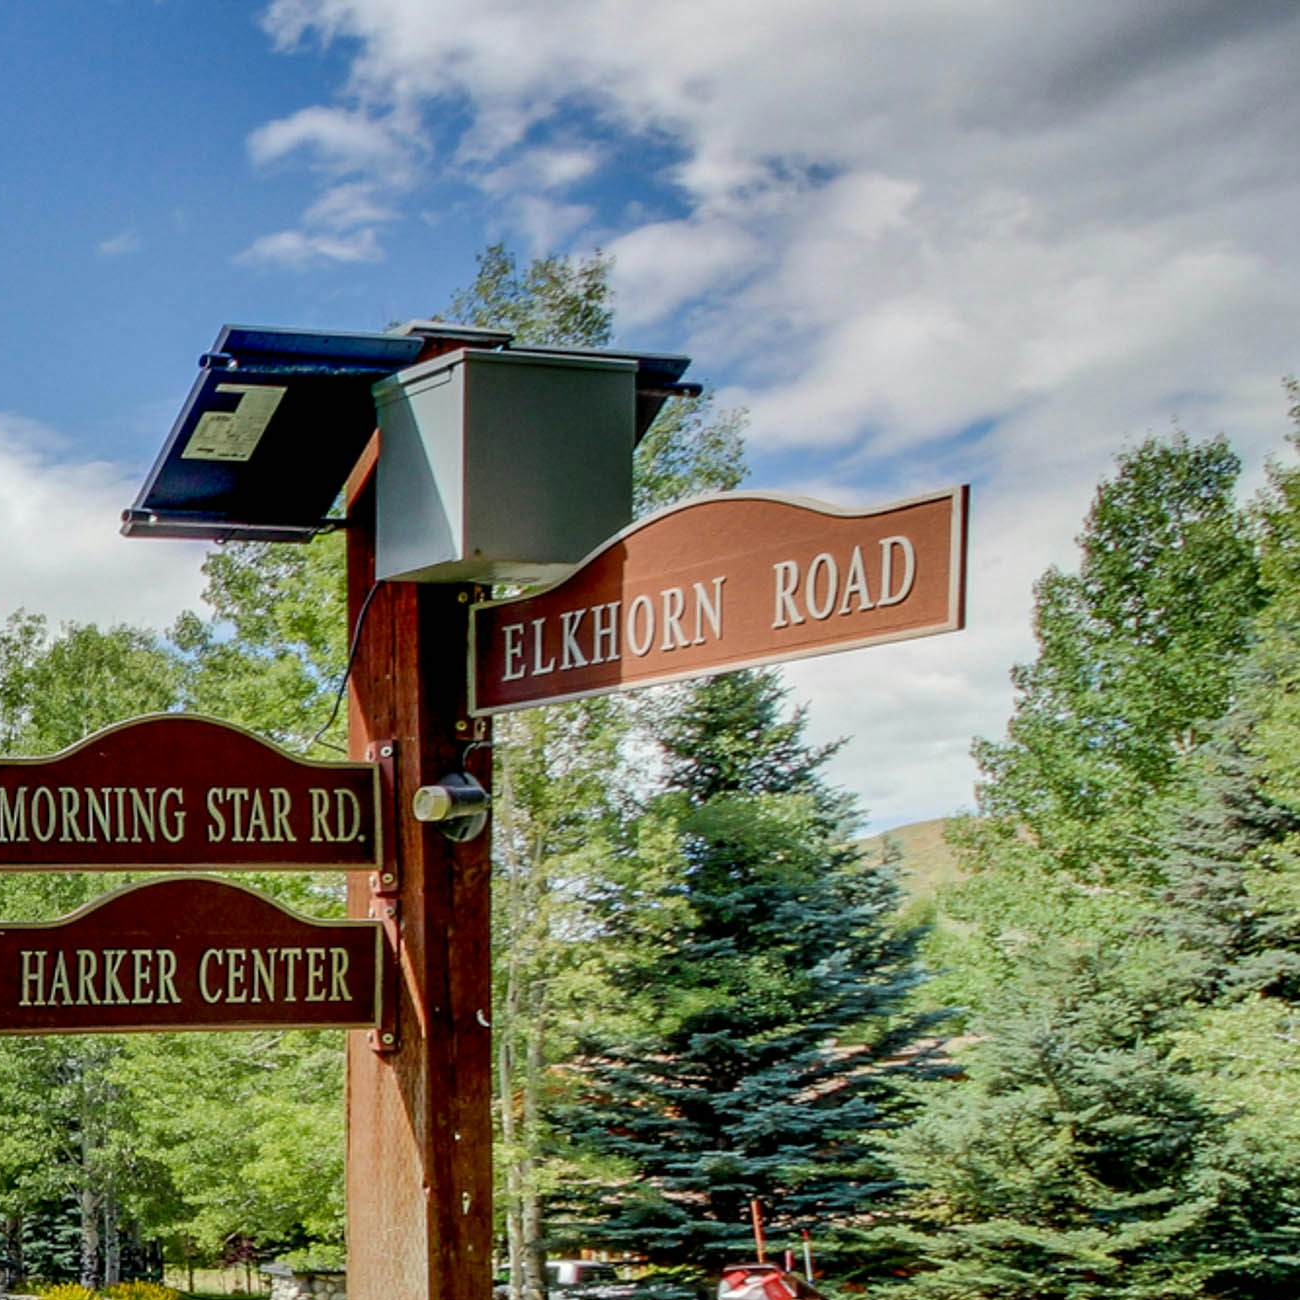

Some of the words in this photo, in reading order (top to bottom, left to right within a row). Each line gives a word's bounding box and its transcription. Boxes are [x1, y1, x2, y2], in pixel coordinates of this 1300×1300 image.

[502, 576, 726, 683] ELKHORN
[771, 535, 917, 630] ROAD
[207, 787, 294, 843] STAR
[309, 788, 367, 843] RD.
[18, 949, 182, 1007] HARKER
[199, 947, 353, 1004] CENTER
